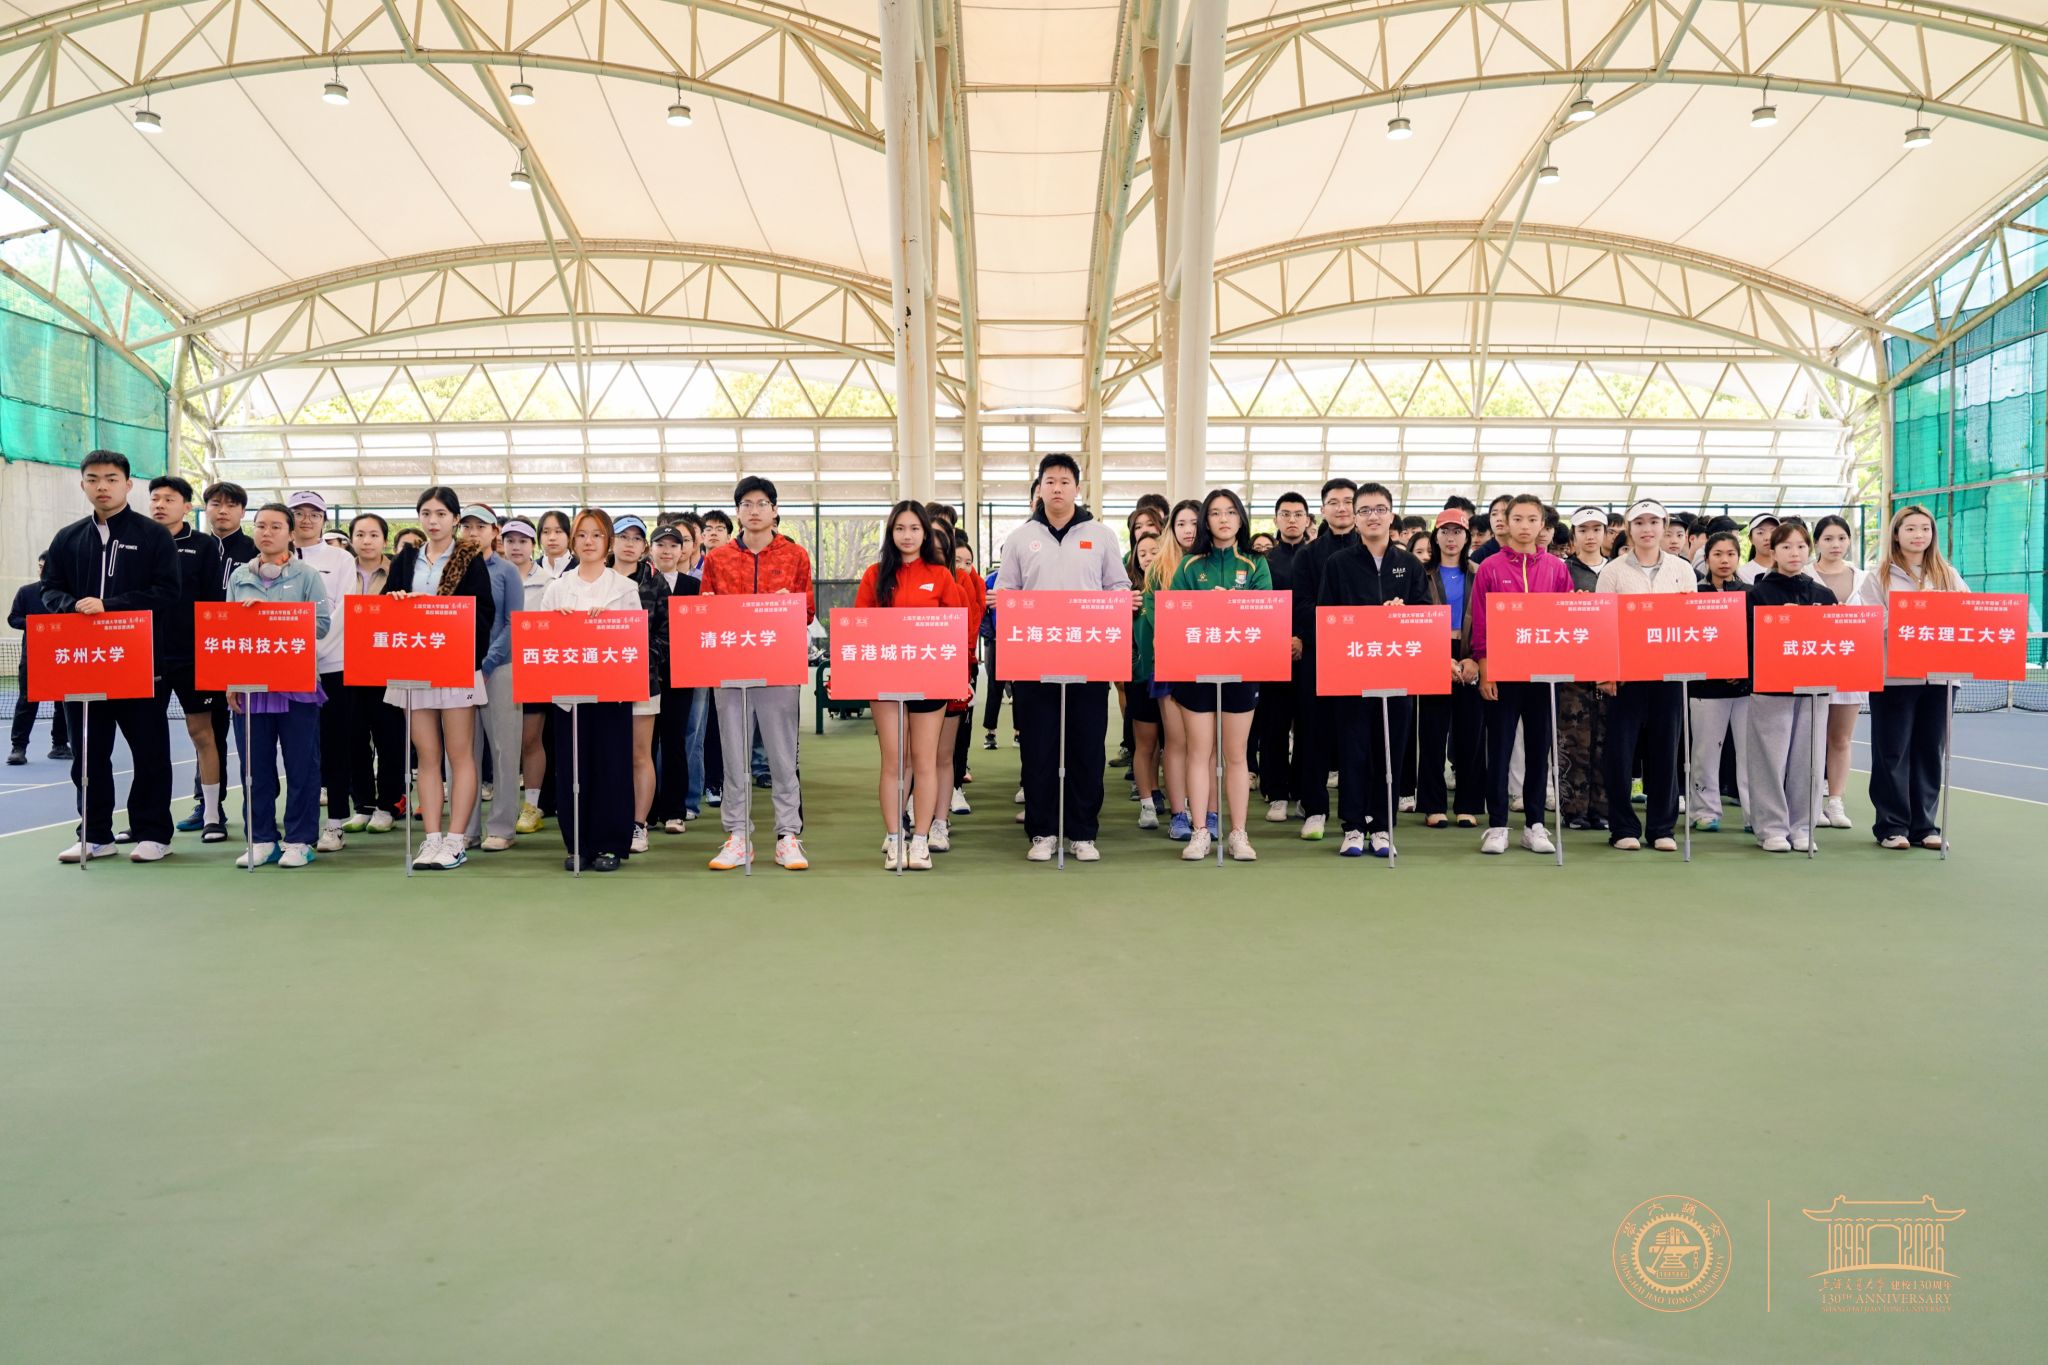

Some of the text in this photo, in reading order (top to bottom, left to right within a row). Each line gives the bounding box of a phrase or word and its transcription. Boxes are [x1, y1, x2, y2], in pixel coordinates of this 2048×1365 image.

[372, 631, 446, 649] 重庆大学
[700, 629, 777, 649] 清华大学
[1006, 625, 1122, 644] 上海交通大学
[1185, 626, 1262, 644] 香港大学
[1515, 627, 1589, 644] 浙江大学
[1647, 625, 1719, 644] 四川大学
[1898, 625, 2016, 644] 华东理工大学
[204, 636, 306, 655] 华中科技大学
[841, 643, 957, 662] 香港城市大学
[1346, 640, 1422, 658] 北京大学
[1782, 639, 1855, 656] 武汉大学
[54, 646, 125, 665] 苏州大学
[522, 646, 639, 665] 西安交通大学
